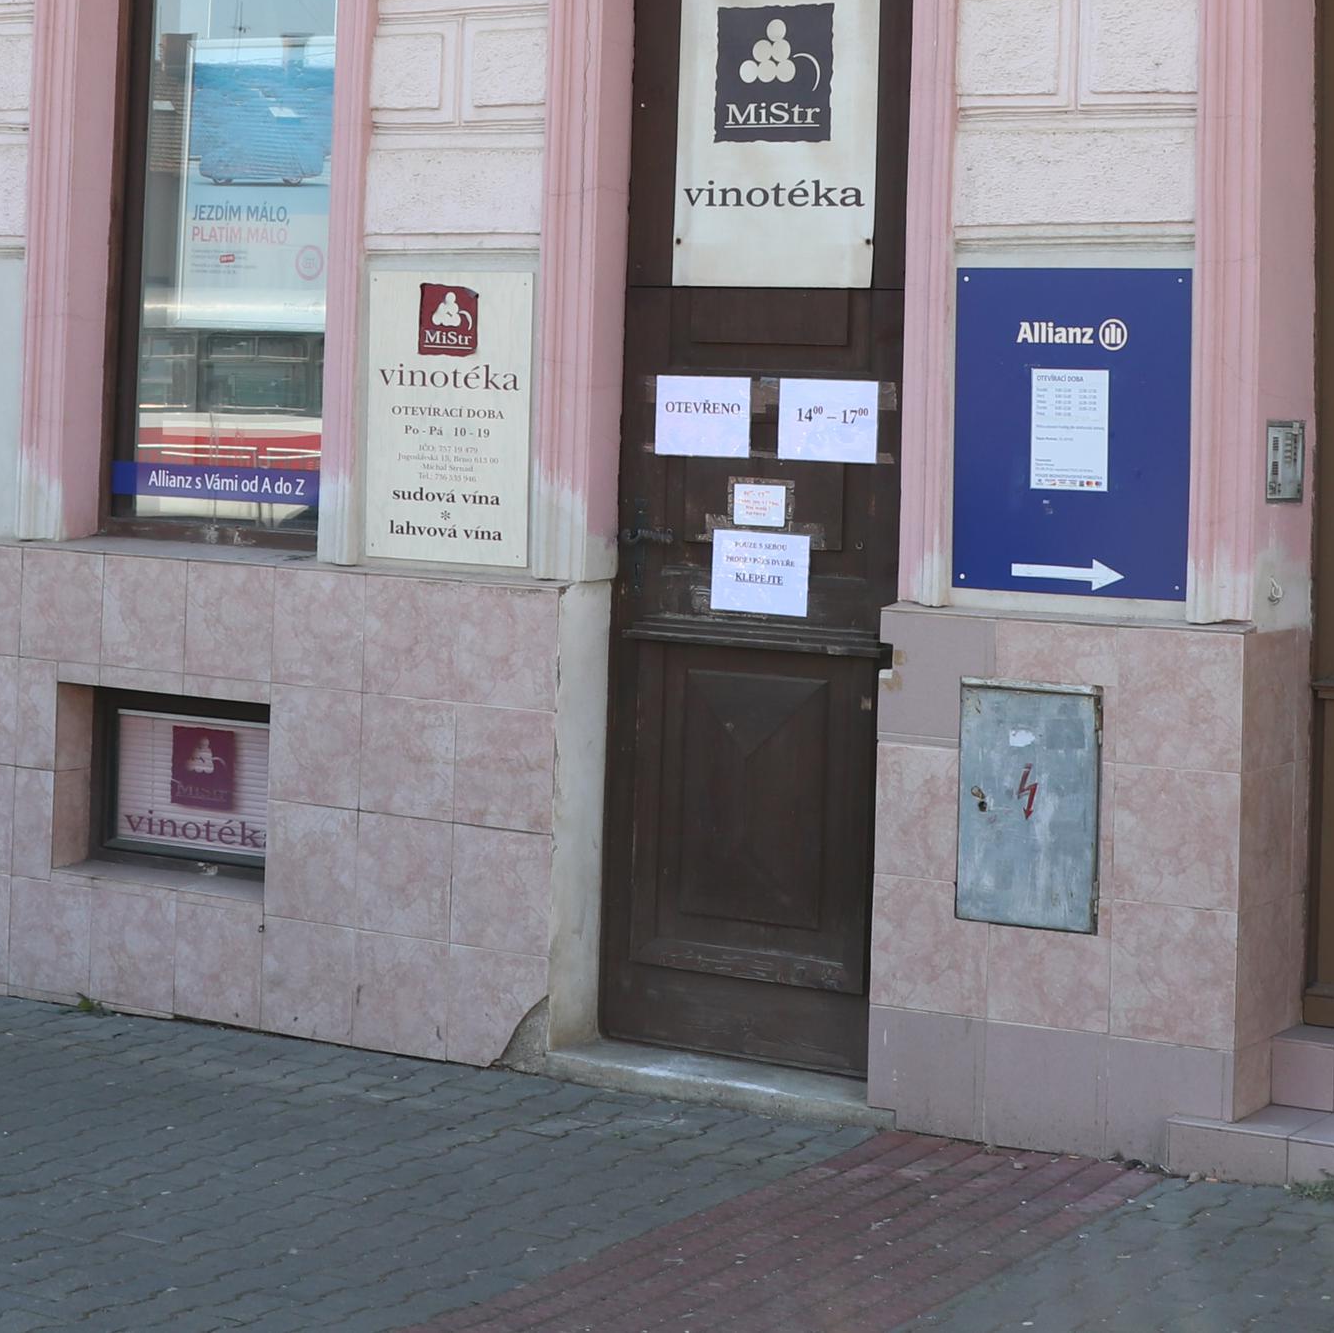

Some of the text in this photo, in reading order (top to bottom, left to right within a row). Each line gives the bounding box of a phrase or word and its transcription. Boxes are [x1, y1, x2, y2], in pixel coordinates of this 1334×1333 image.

[725, 102, 821, 125] MiStr
[683, 179, 866, 207] vinotéka
[192, 200, 290, 226] JEZDÍM MÁLO,
[191, 223, 288, 244] PLATÍM MÁLO
[424, 330, 472, 345] MiStr
[1016, 321, 1094, 344] Allianz
[379, 363, 520, 391] vinotéka
[391, 404, 505, 420] OTEVÍRACÍ DOBA
[665, 400, 741, 415] OTEVŘENO
[404, 425, 419, 435] Po
[429, 426, 443, 436] Pá
[453, 427, 466, 437] 10
[477, 428, 490, 438] 19
[148, 470, 305, 496] Allianz s Vámi od A do Z
[392, 486, 500, 506] sudová vína
[389, 519, 502, 541] lahvová vína
[735, 572, 784, 585] KLEPEJTE
[124, 809, 267, 849] vinoték
